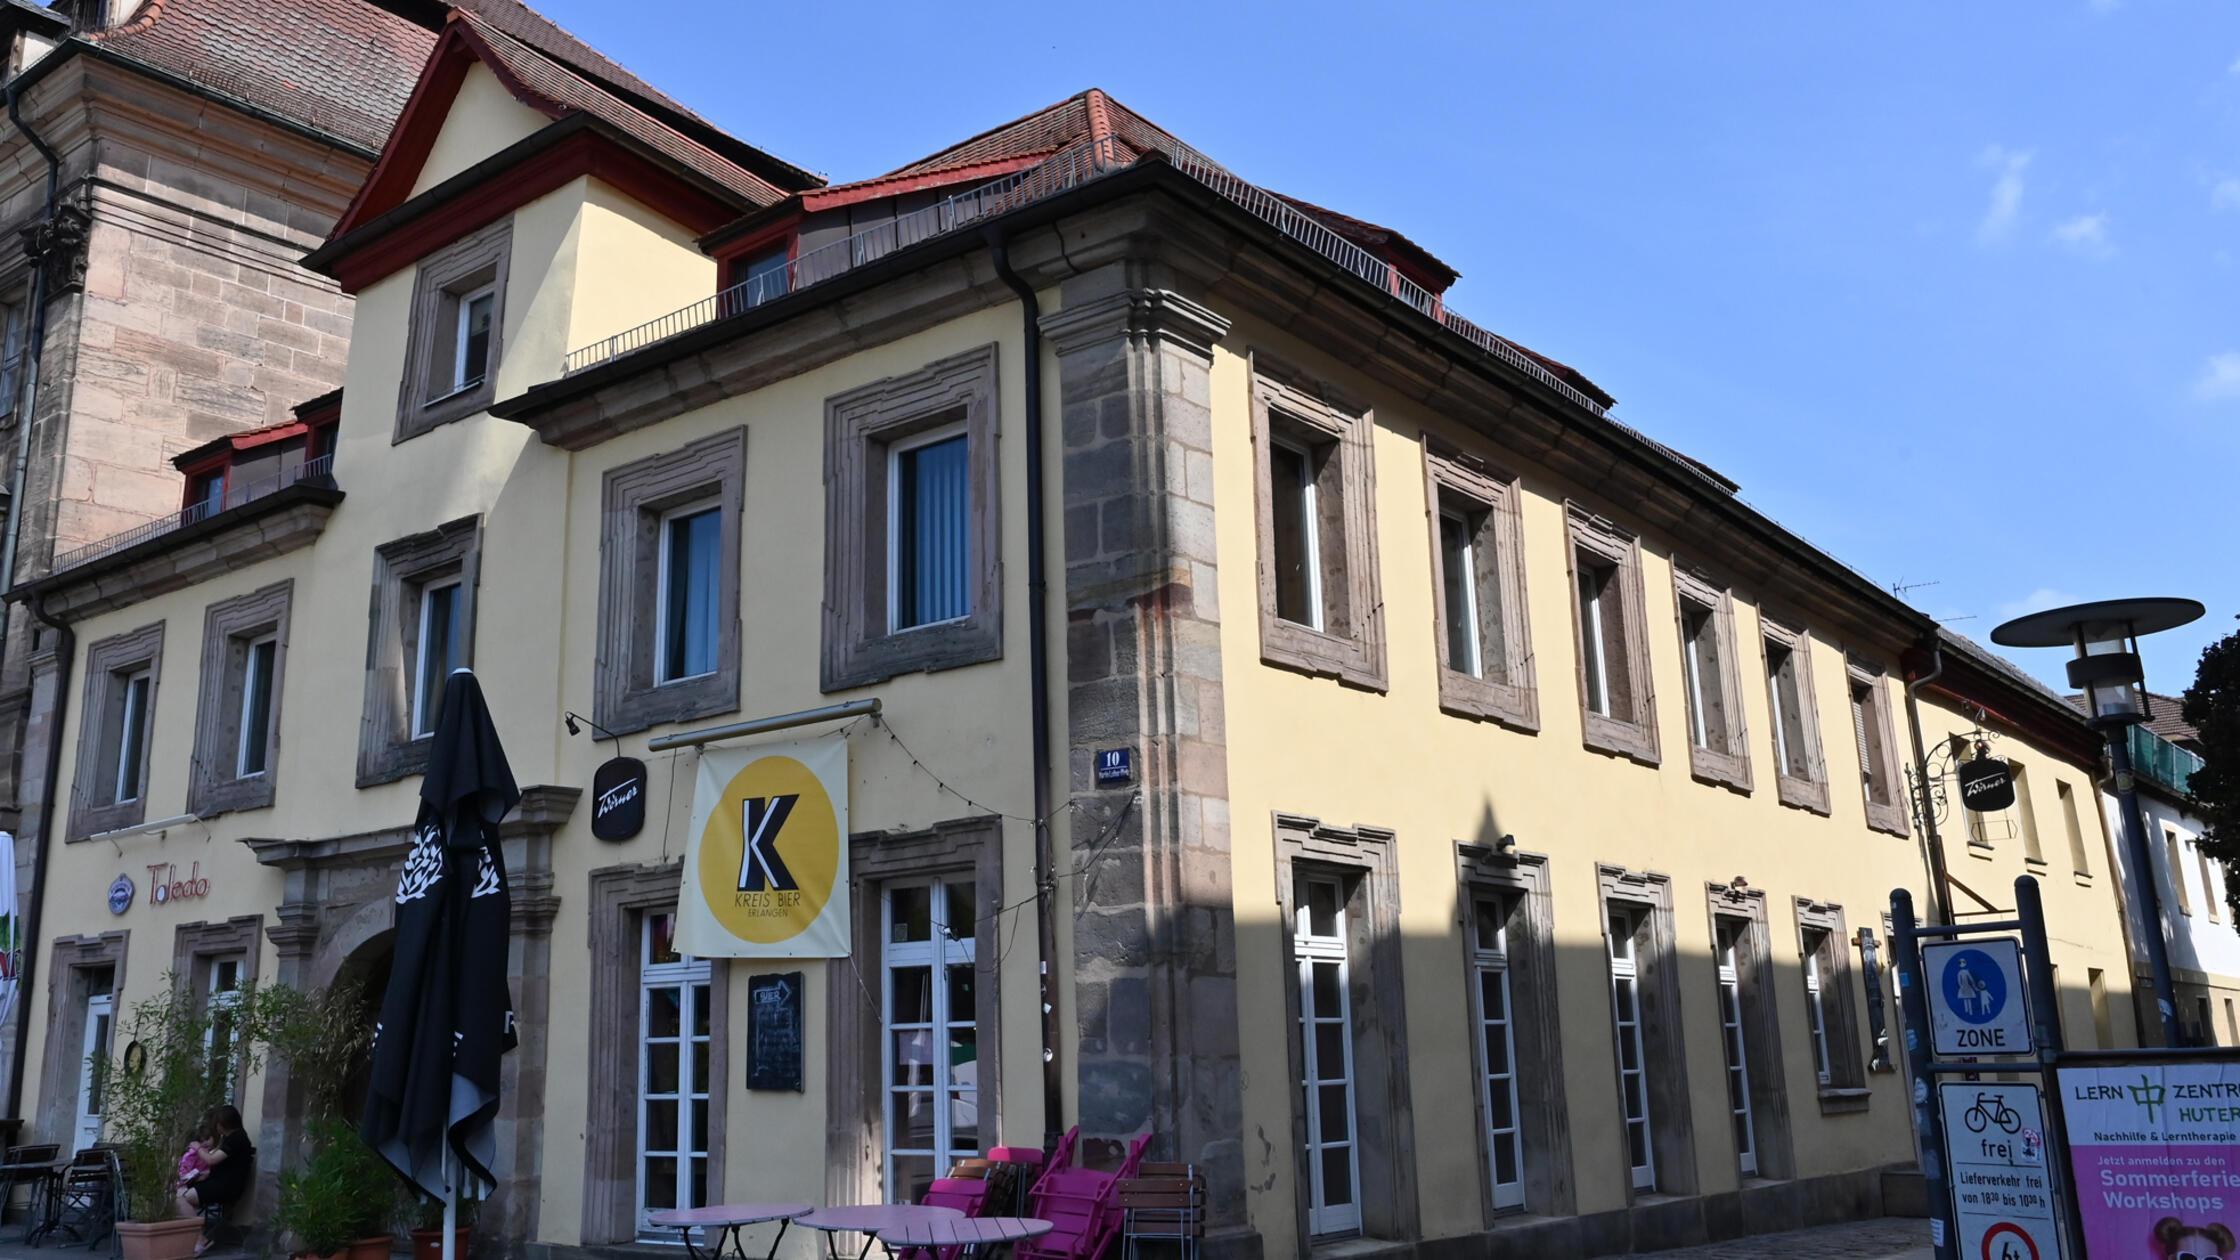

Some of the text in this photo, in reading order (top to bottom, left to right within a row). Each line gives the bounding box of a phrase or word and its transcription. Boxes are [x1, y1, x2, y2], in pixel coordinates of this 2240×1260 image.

[1106, 751, 1120, 767] 10
[737, 794, 800, 891] K
[146, 860, 209, 905] Toledo
[734, 891, 801, 908] KREIS BIER
[747, 908, 789, 917] ERLANGEN
[1956, 1028, 2006, 1047] ZONE
[2075, 1085, 2124, 1100] LERN
[2179, 1107, 2240, 1122] HUTER
[2094, 1131, 2237, 1143] Nachhilfe & Lerntherapie
[1981, 1139, 2013, 1158] frei
[2097, 1156, 2226, 1166] Jetzt anmelden zu den
[1960, 1171, 2043, 1189] Lieferverkehr frei
[1961, 1193, 1979, 1203] von
[2003, 1193, 2016, 1206] bis
[2039, 1196, 2046, 1208] h
[2102, 1191, 2224, 1213] Workshops
